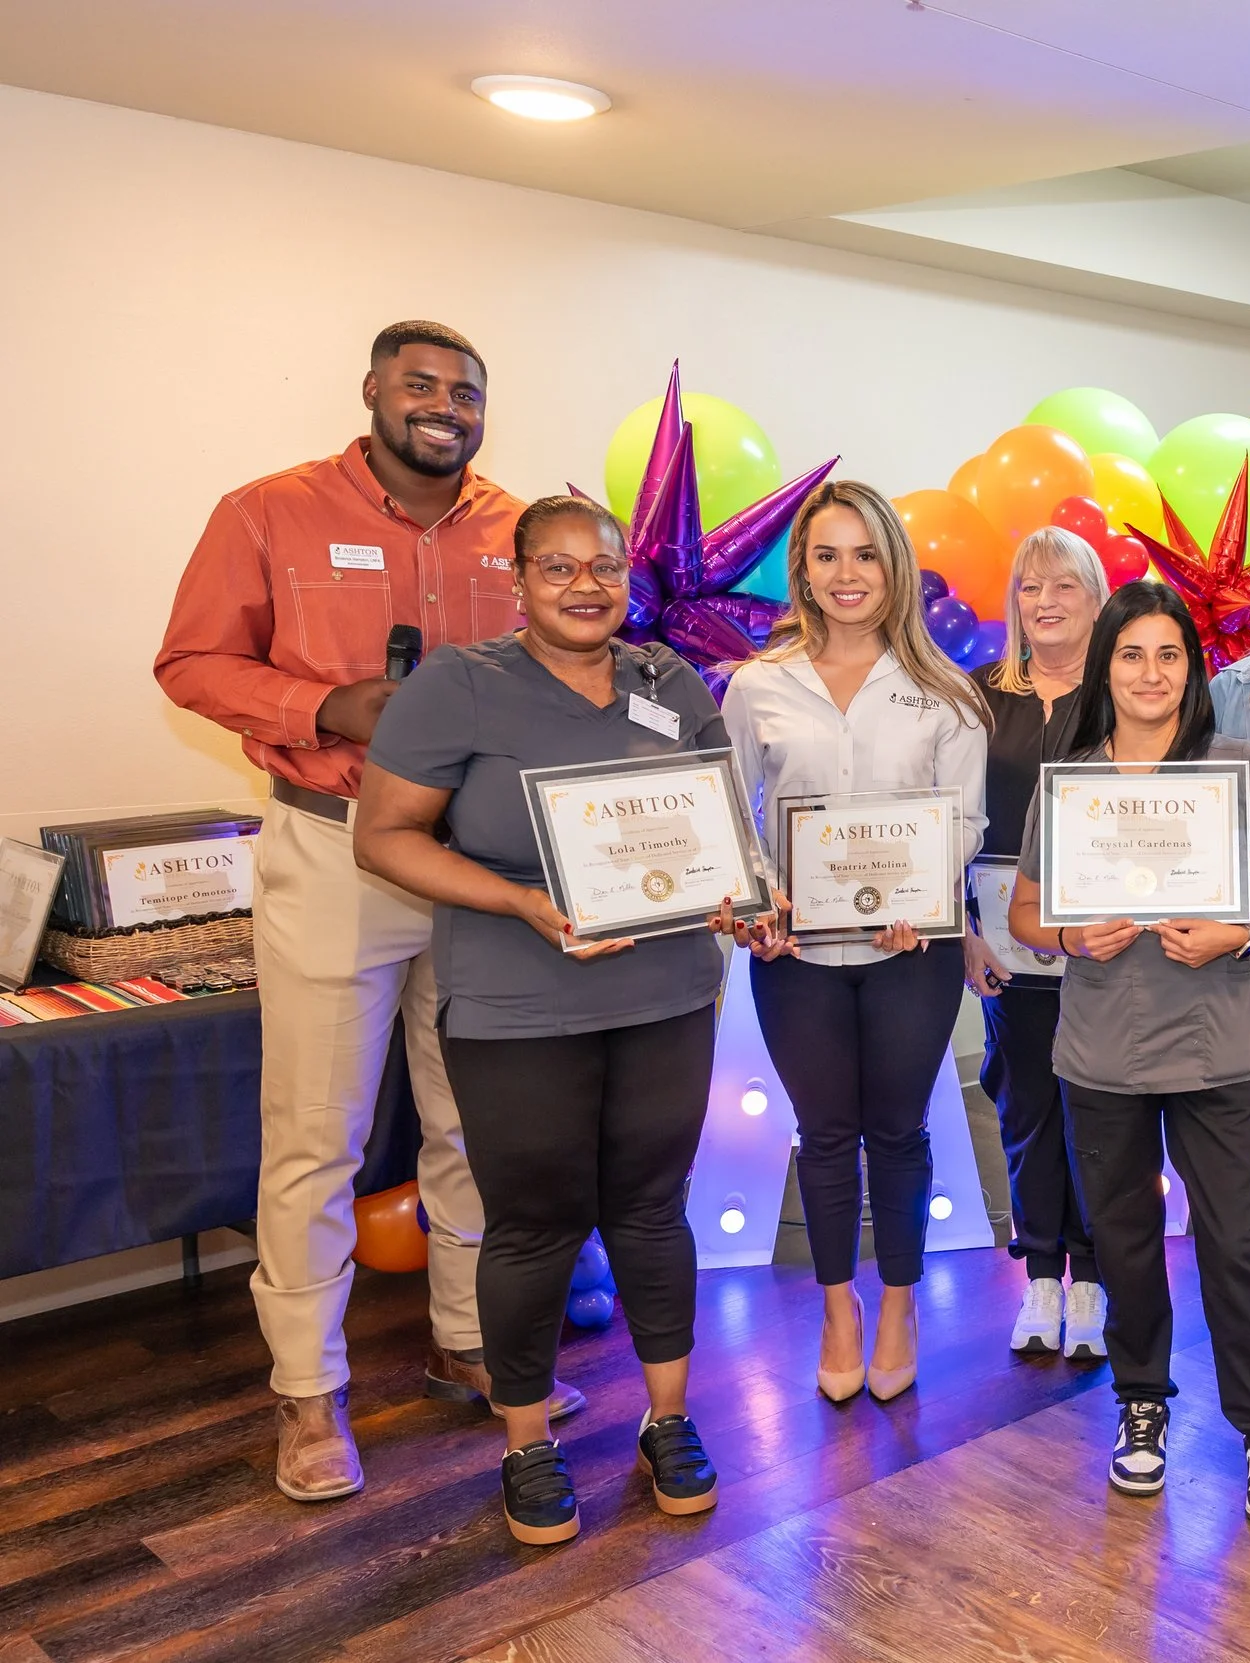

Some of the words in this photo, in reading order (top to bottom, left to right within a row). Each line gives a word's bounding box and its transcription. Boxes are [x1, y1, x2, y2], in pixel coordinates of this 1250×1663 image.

[343, 548, 378, 556] ASHTON
[492, 556, 514, 567] ASH
[900, 696, 940, 708] ASHTON
[600, 792, 696, 819] ASHTON
[1103, 800, 1197, 815] ASHTON
[834, 822, 919, 841] ASHTON
[608, 844, 635, 856] Lola
[638, 837, 688, 851] Timothy
[1091, 840, 1134, 850] Crystal
[1138, 840, 1192, 848] Cardenas
[149, 854, 234, 876] ASHTON
[830, 862, 867, 872] Beatriz
[871, 860, 907, 869] Molina
[140, 894, 189, 906] Temitope
[192, 888, 237, 899] Omotoso
